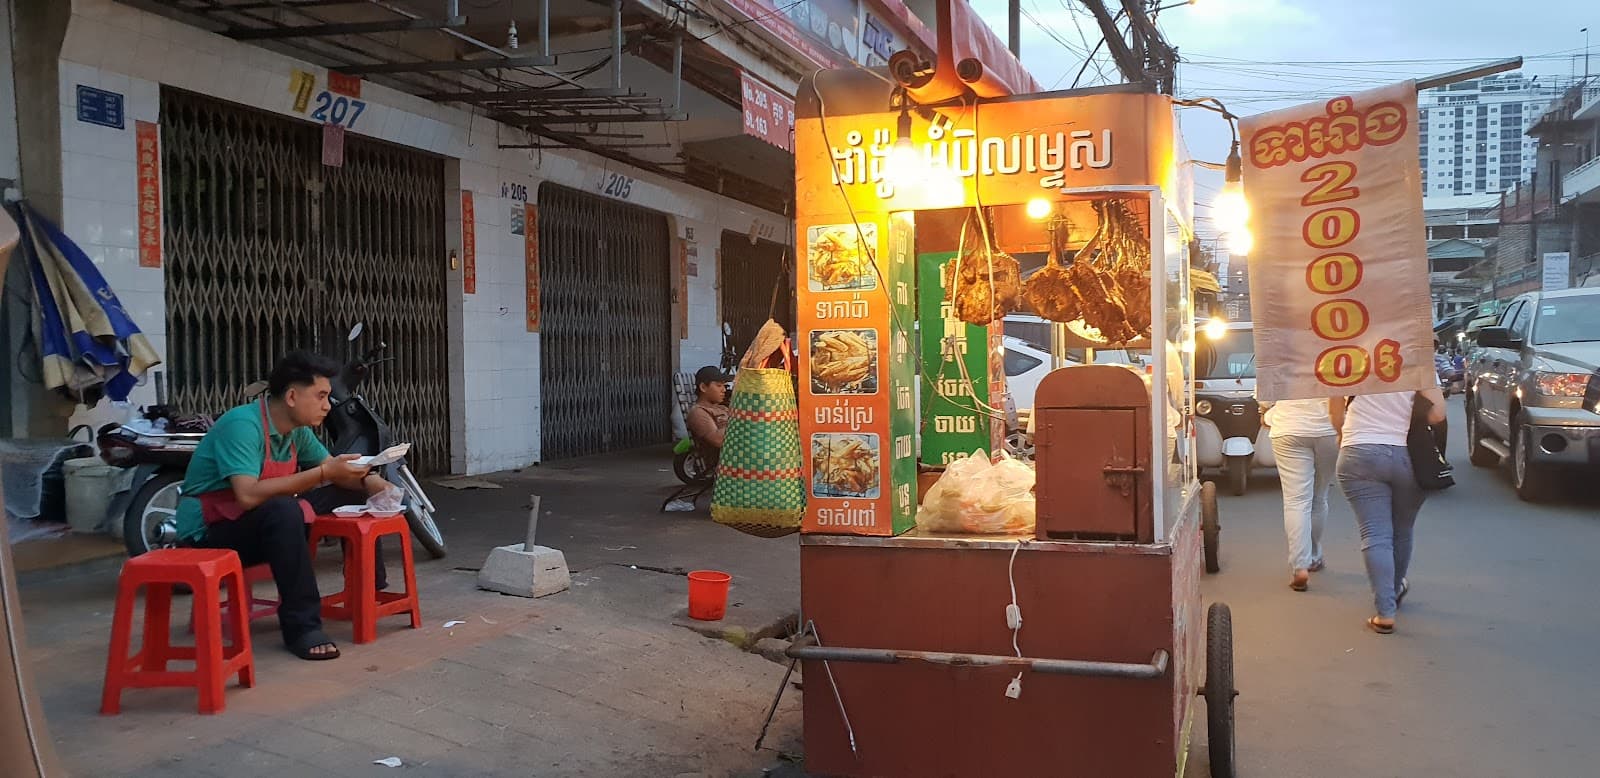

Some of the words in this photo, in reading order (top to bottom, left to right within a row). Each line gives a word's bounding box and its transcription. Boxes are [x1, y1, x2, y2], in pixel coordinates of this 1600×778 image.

[311, 91, 366, 128] 207
[1251, 96, 1407, 169] ទាអាំង
[511, 183, 528, 202] 205
[604, 173, 633, 199] 205
[815, 294, 870, 319] ទាកាប៉ា
[815, 400, 873, 431] មាន់ស្រែ
[934, 415, 975, 433] ចាយ
[895, 435, 912, 460] ចាយ
[817, 501, 875, 527] ទាសំពៅ
